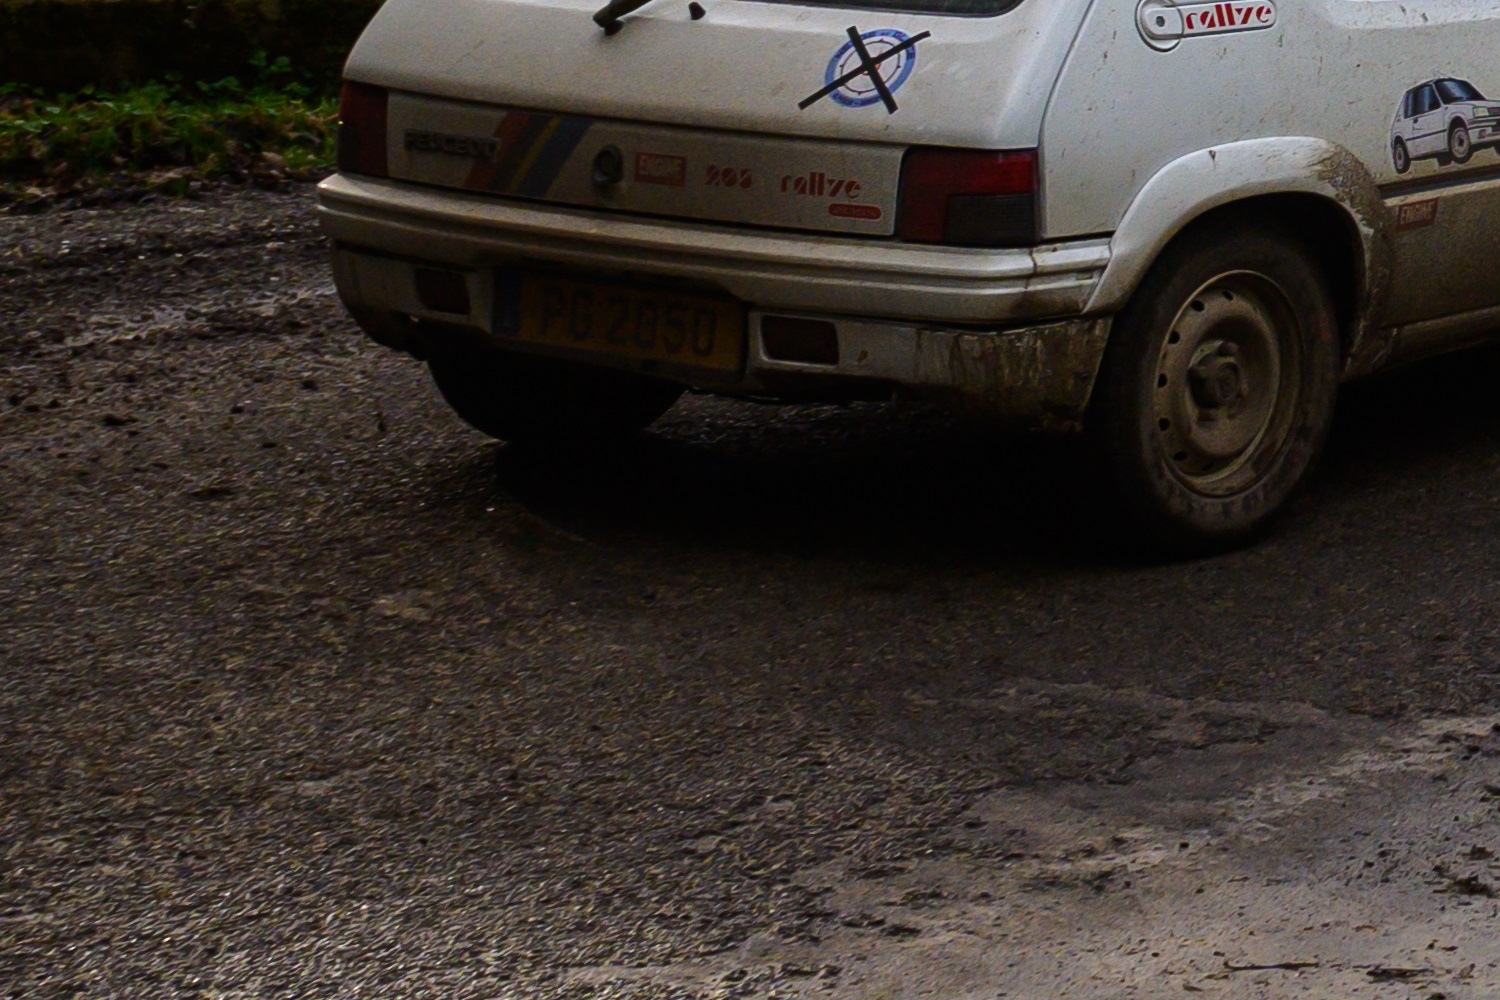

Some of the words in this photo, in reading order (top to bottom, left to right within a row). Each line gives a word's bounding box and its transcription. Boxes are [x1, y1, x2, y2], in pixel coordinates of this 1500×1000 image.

[1185, 2, 1273, 31] rallye
[704, 164, 753, 190] 205
[780, 171, 862, 199] rallye
[542, 285, 594, 341] PG
[606, 294, 717, 357] 2050
